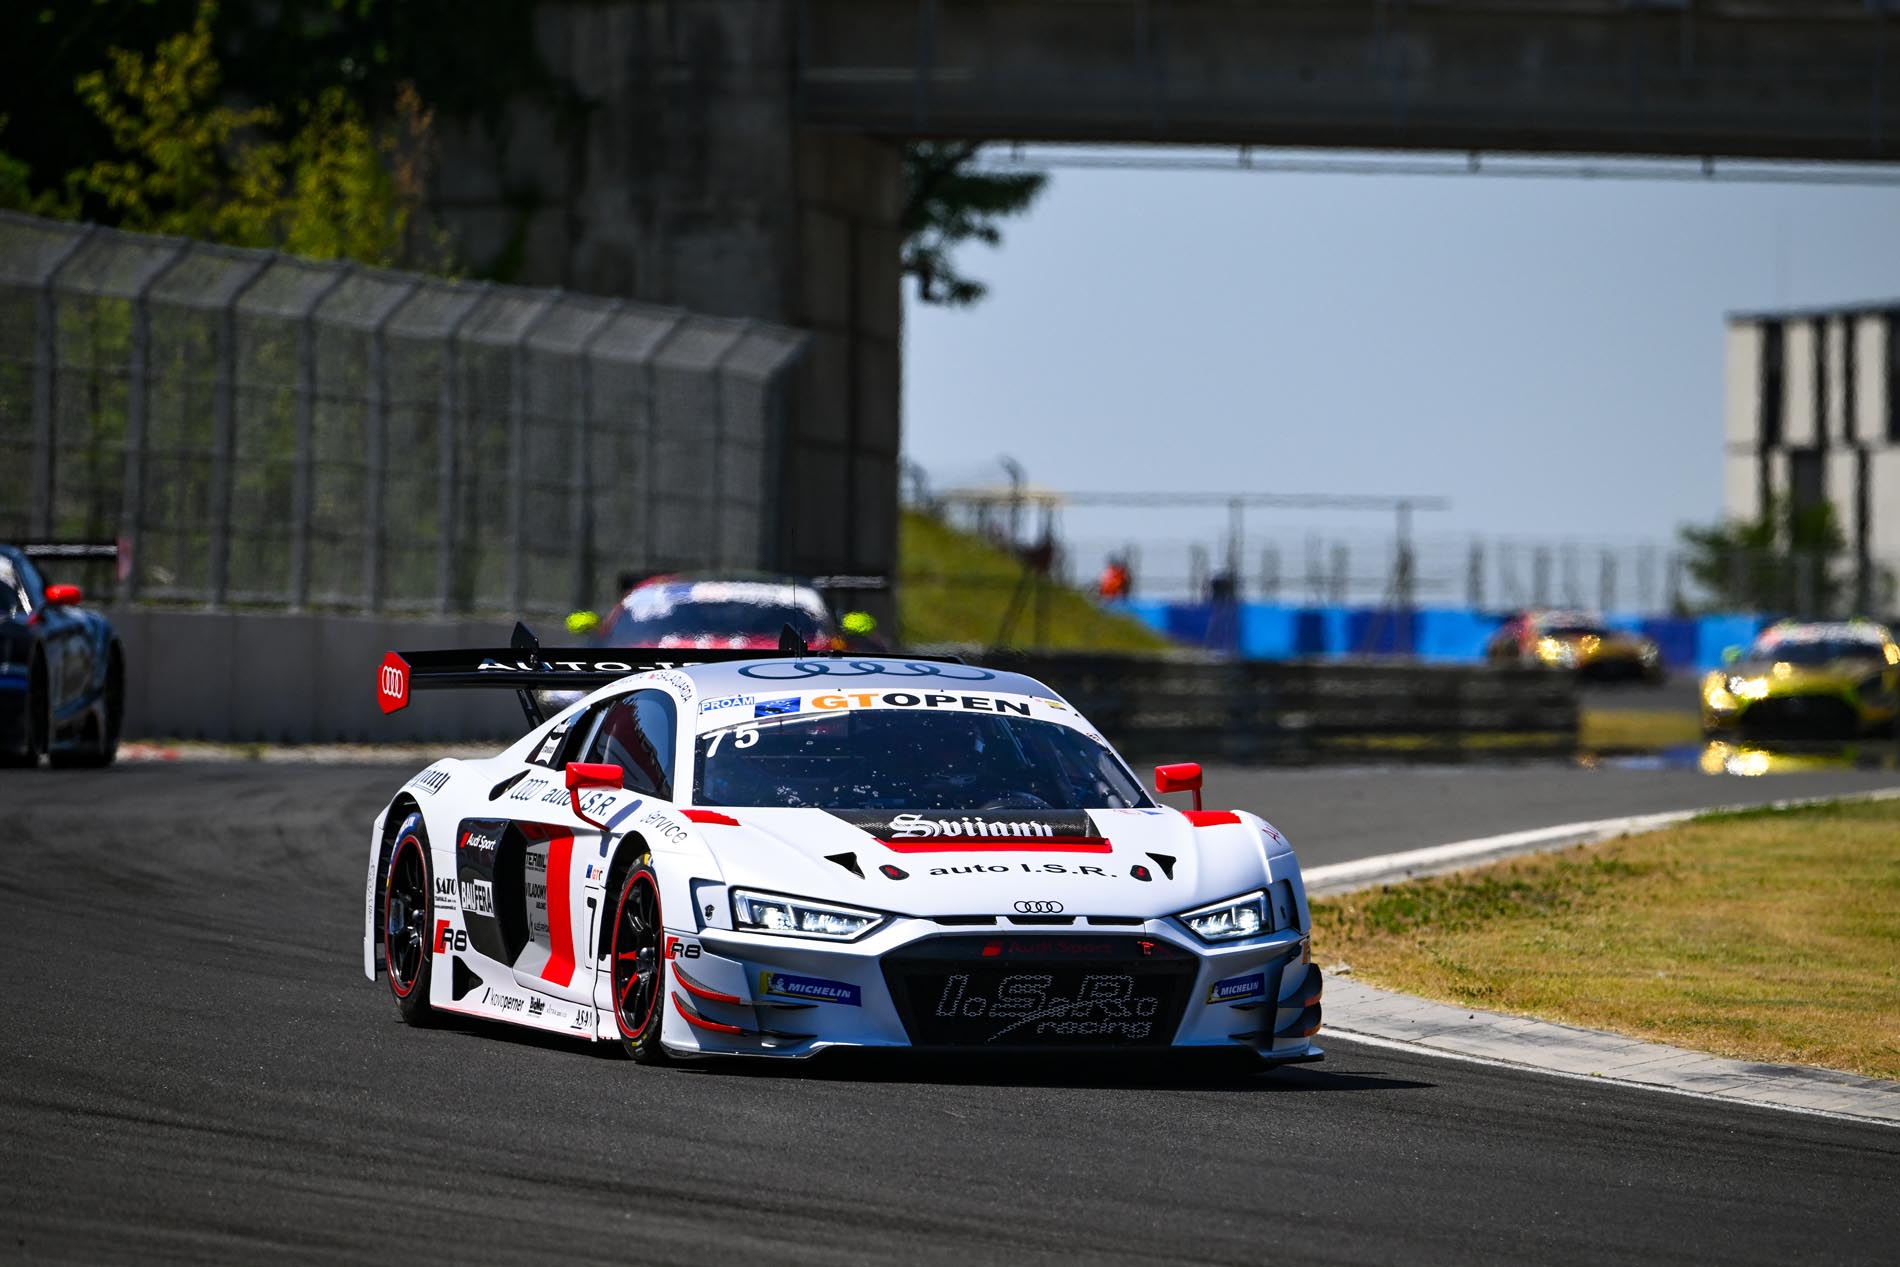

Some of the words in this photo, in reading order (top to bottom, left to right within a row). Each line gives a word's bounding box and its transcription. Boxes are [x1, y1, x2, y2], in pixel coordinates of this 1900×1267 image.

[702, 696, 755, 711] PROAM
[700, 722, 760, 758] 75
[466, 833, 480, 847] Audi
[479, 834, 497, 852] Sport
[930, 863, 1009, 876] auto
[1021, 863, 1118, 878] I.S.R.
[441, 928, 468, 952] R8
[670, 942, 701, 958] R8
[788, 983, 852, 998] MICHELIN
[1220, 981, 1259, 996] MICHELIN
[1037, 1020, 1152, 1039] racing
